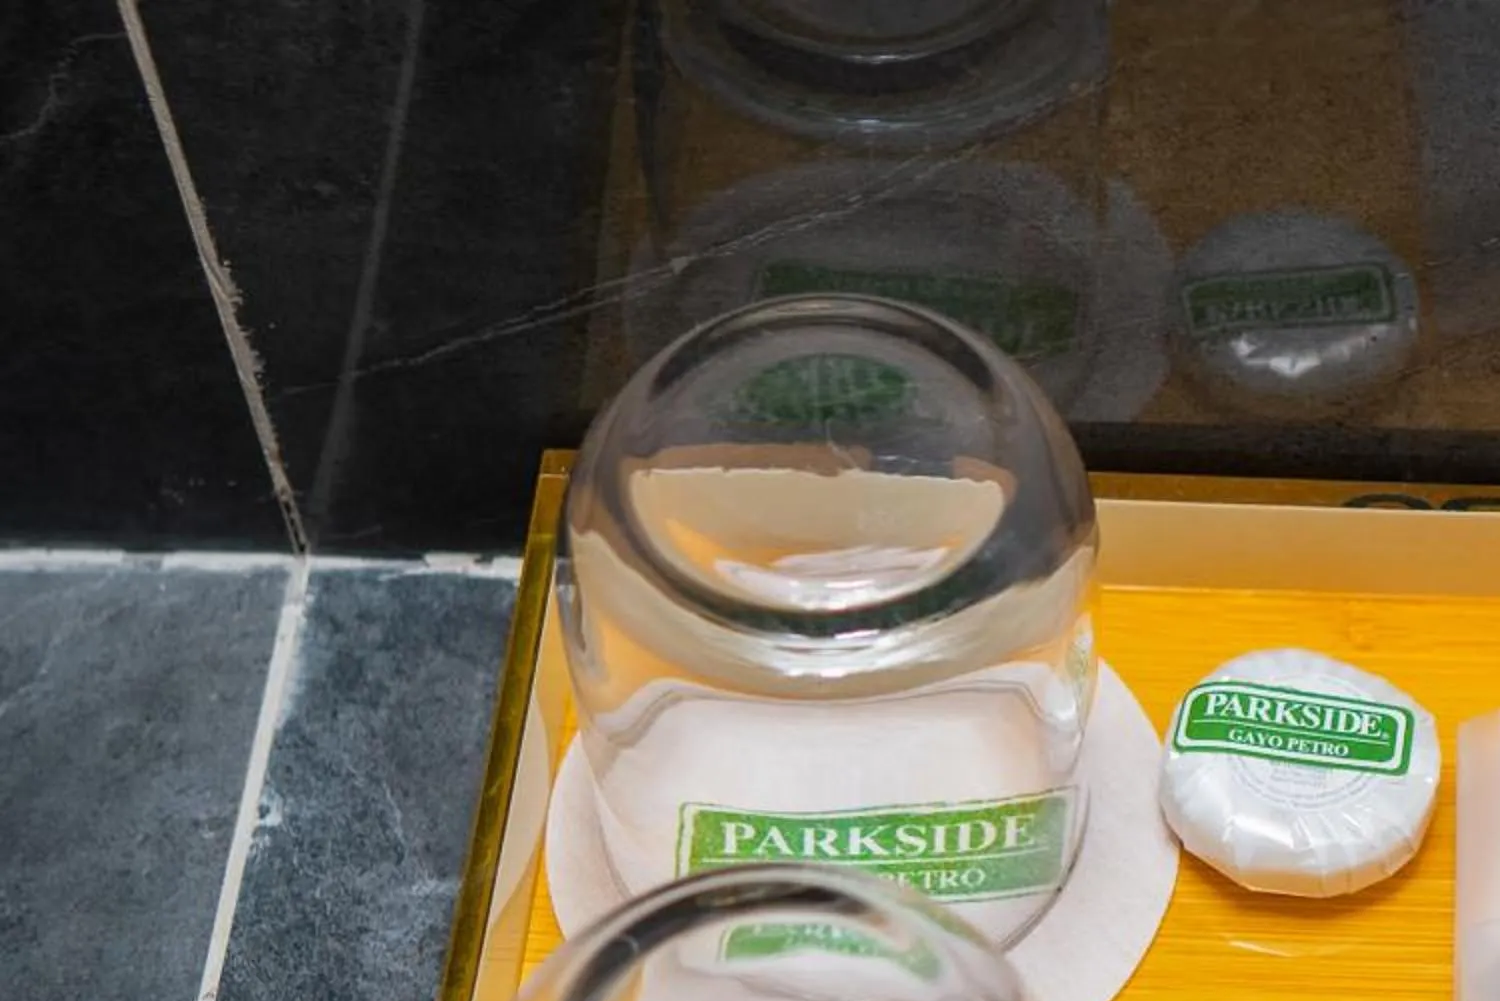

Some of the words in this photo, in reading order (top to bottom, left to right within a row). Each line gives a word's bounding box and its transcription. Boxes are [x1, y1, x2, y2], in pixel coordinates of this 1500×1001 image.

[1204, 693, 1382, 737] PARKSIDE
[1229, 728, 1283, 748] GAYO
[1287, 739, 1349, 757] PETRO
[719, 812, 1037, 859] PARKSIDE
